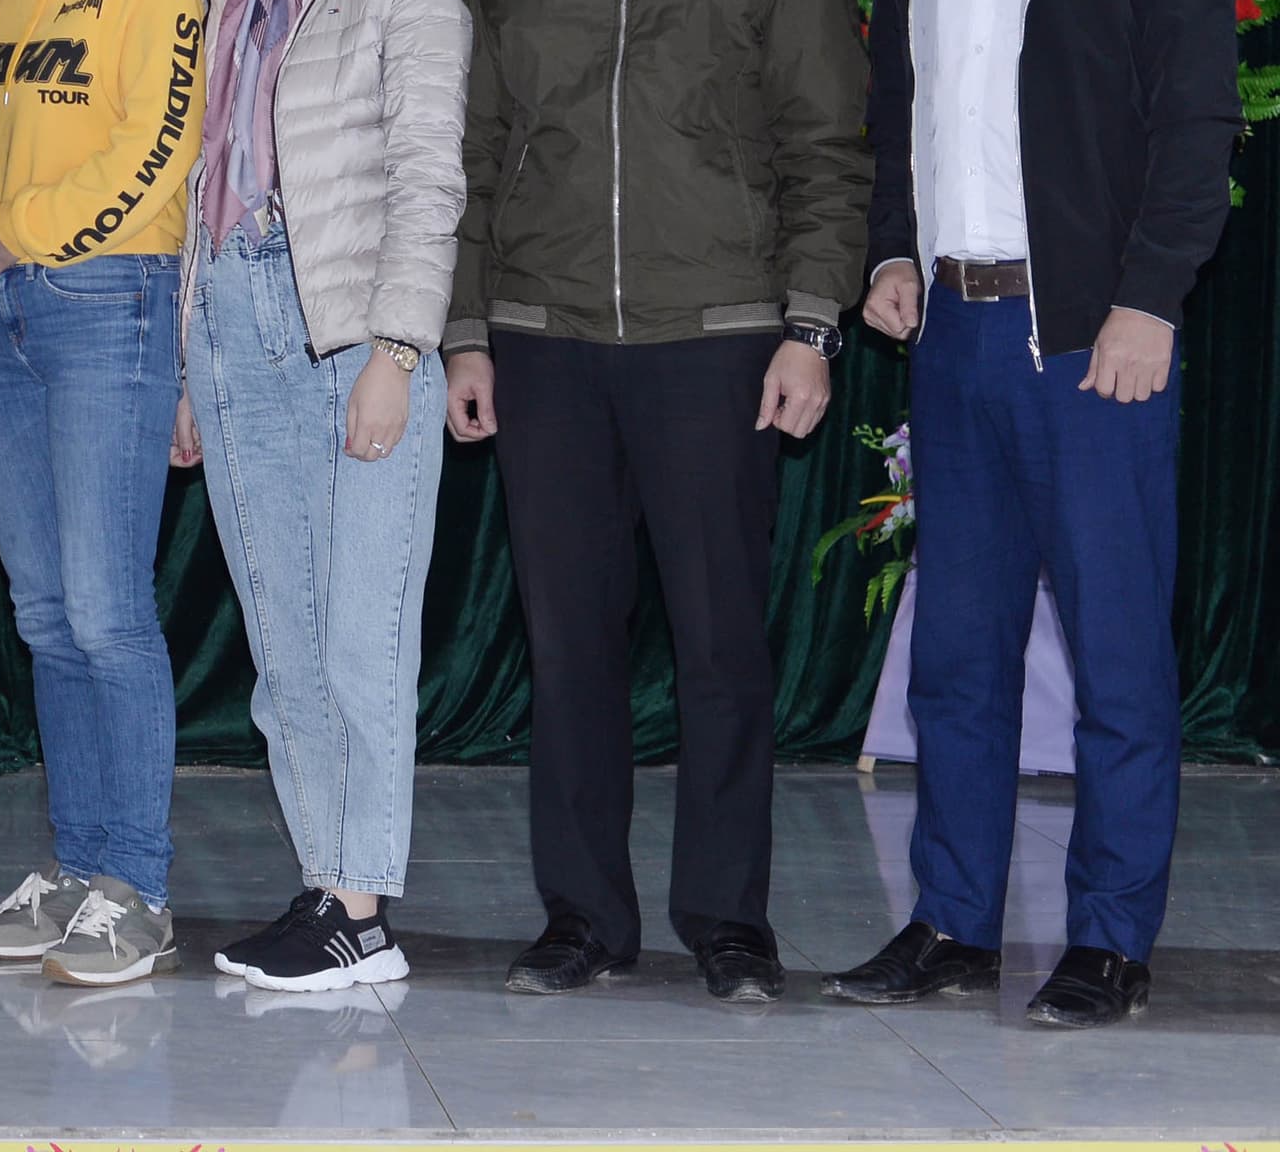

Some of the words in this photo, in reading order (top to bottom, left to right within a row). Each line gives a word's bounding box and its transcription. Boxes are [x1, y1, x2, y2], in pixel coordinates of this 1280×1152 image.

[38, 89, 90, 106] TOUR
[134, 12, 202, 187] STADIUM
[47, 189, 145, 263] TOUR
